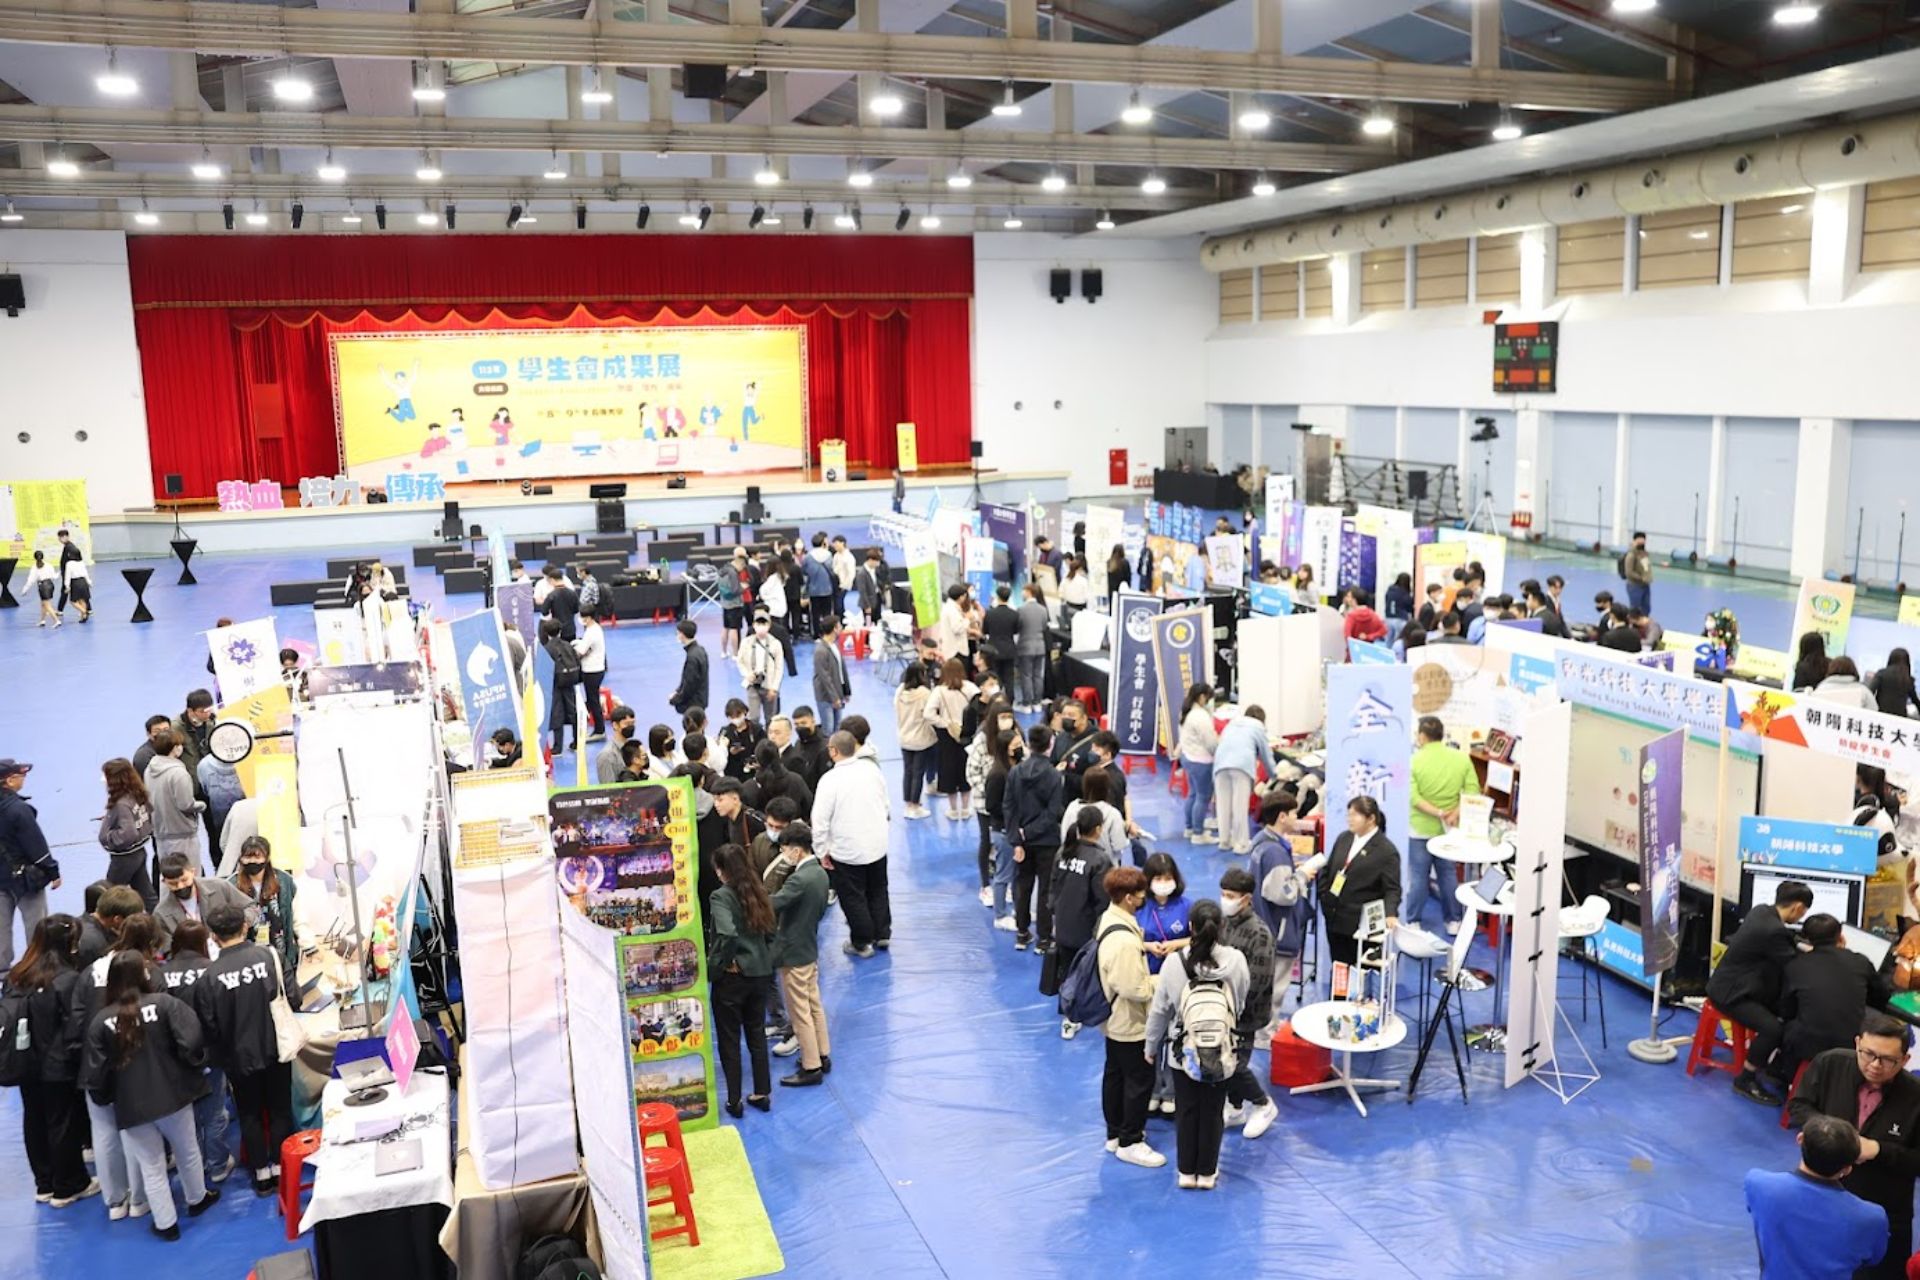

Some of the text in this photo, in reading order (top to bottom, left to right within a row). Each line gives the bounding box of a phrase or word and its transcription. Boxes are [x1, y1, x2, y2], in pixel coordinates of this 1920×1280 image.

[518, 353, 681, 381] 學生會成果展
[217, 472, 446, 512] 熱血 培力 傳承
[1134, 653, 1147, 690] 學生會
[1771, 838, 1844, 855] 朝陽科技大學
[1665, 843, 1680, 925] 學生會
[217, 962, 269, 990] WSU
[104, 1004, 159, 1033] WU
